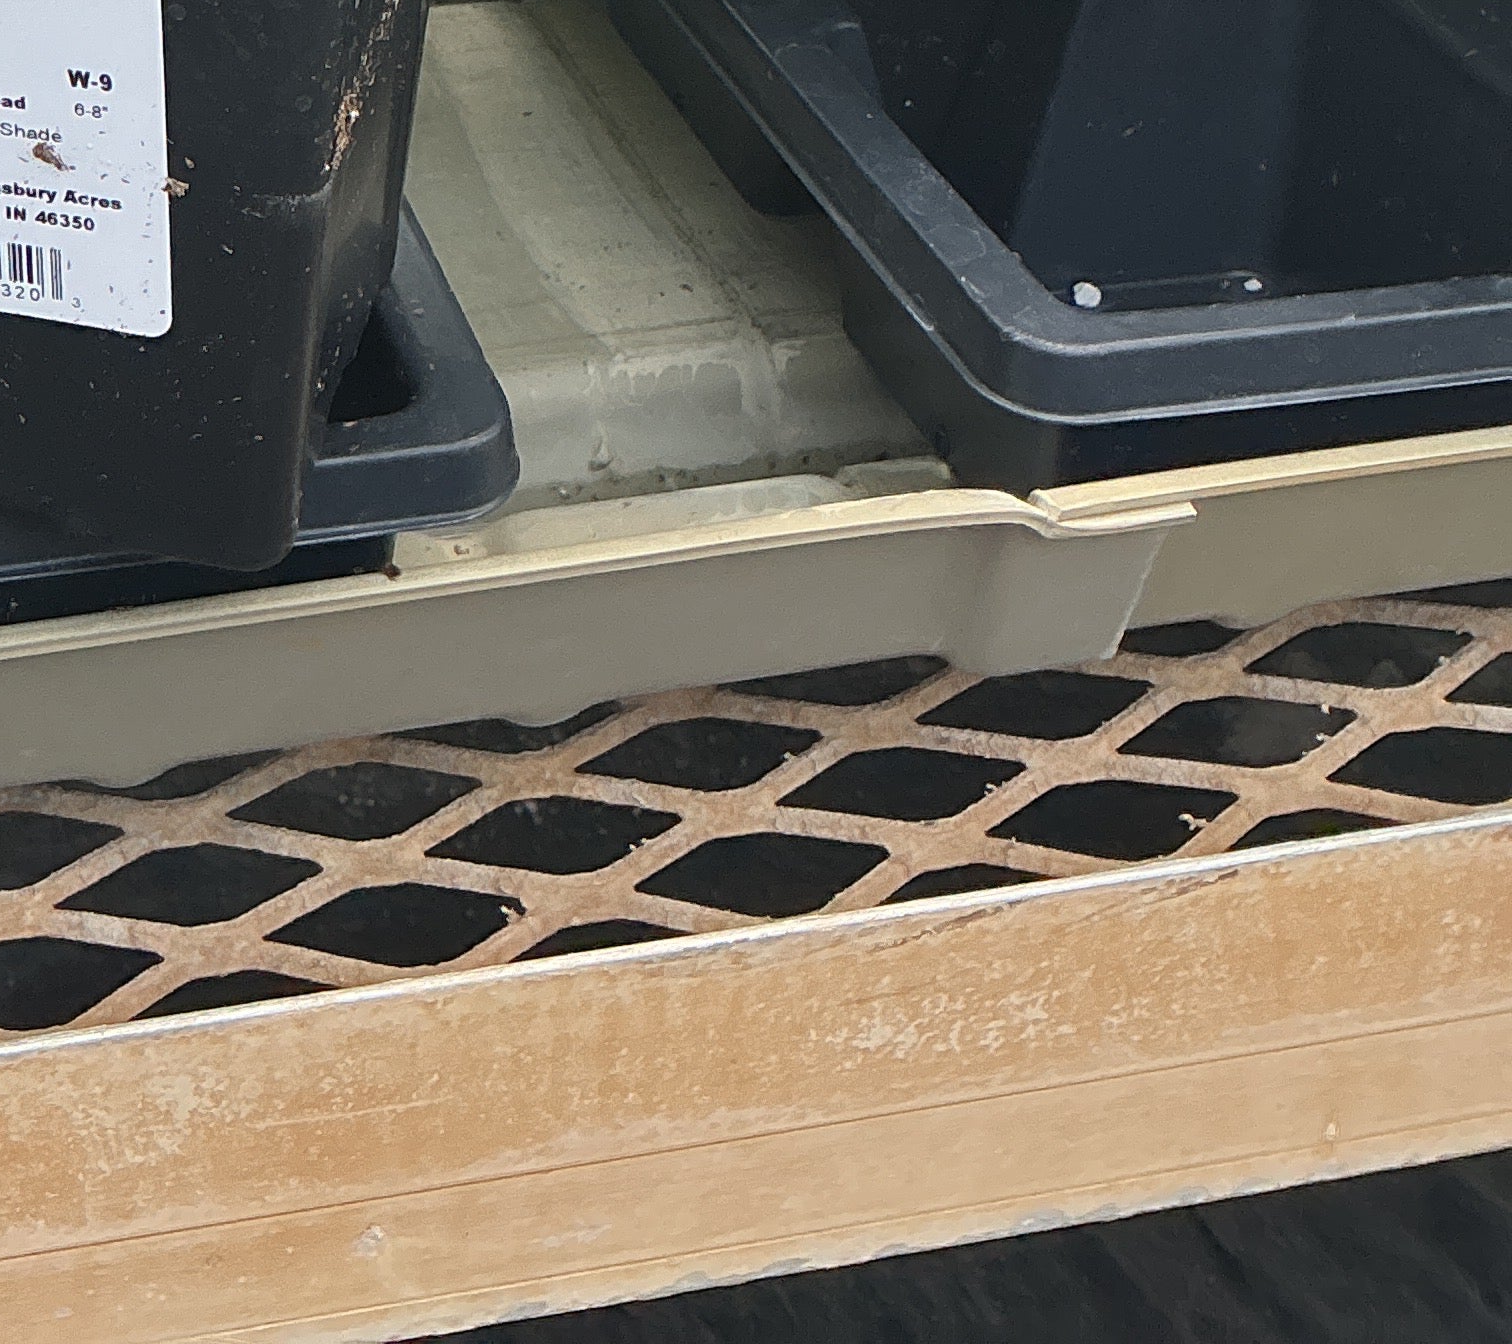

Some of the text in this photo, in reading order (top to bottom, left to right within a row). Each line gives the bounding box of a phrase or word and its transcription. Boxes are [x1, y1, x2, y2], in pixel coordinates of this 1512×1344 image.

[67, 69, 113, 91] W-9
[0, 123, 63, 143] Shade
[64, 190, 122, 210] Acres
[6, 206, 27, 222] IN
[35, 211, 95, 231] 46350
[71, 298, 81, 308] 3
